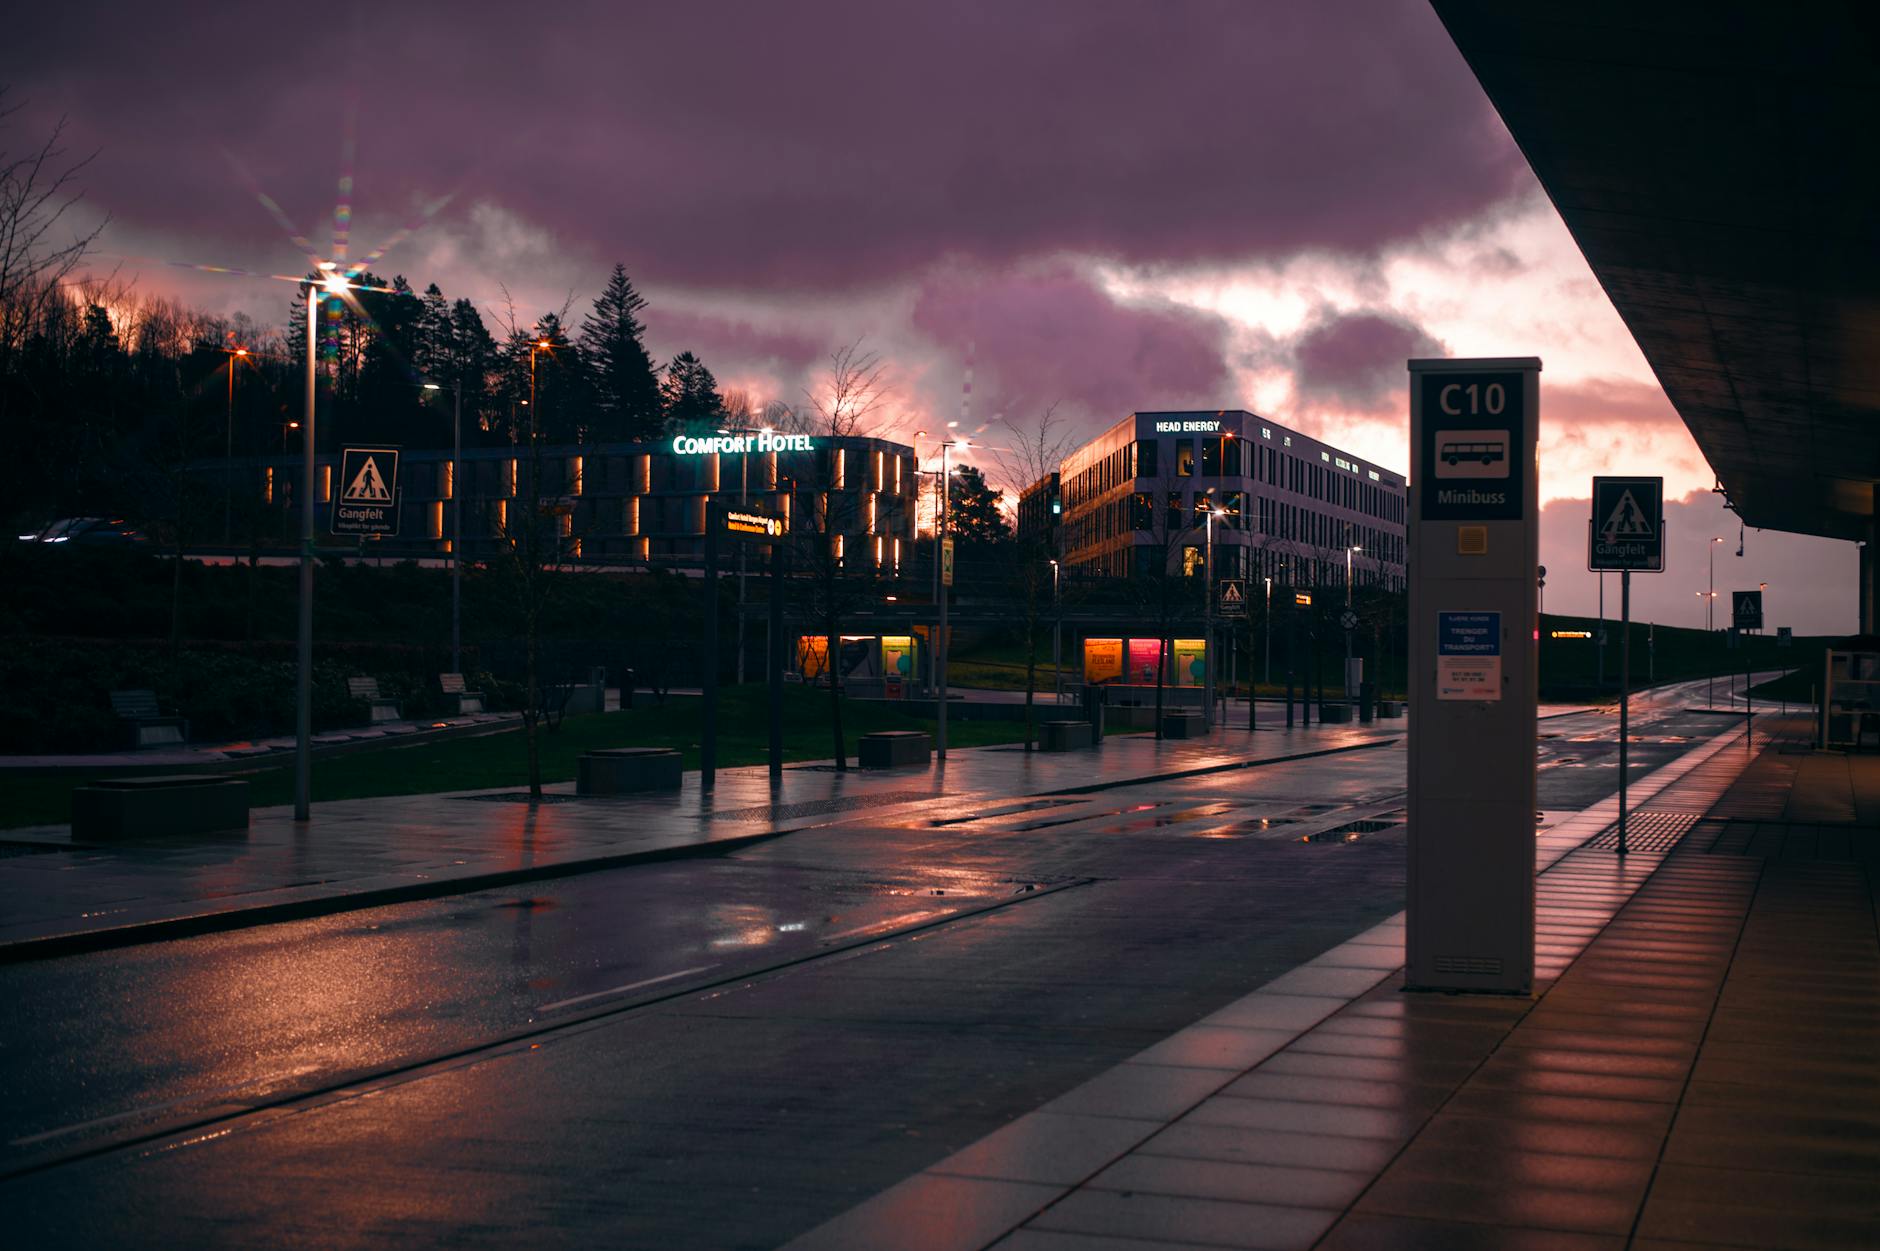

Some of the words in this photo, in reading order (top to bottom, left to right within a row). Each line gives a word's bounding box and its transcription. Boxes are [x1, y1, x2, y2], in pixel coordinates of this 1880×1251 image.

[1440, 383, 1506, 415] C10
[1156, 421, 1182, 433] HEAD
[1183, 420, 1220, 432] ENERGY
[1437, 489, 1506, 504] Minibuss
[338, 508, 384, 522] Gangfelt
